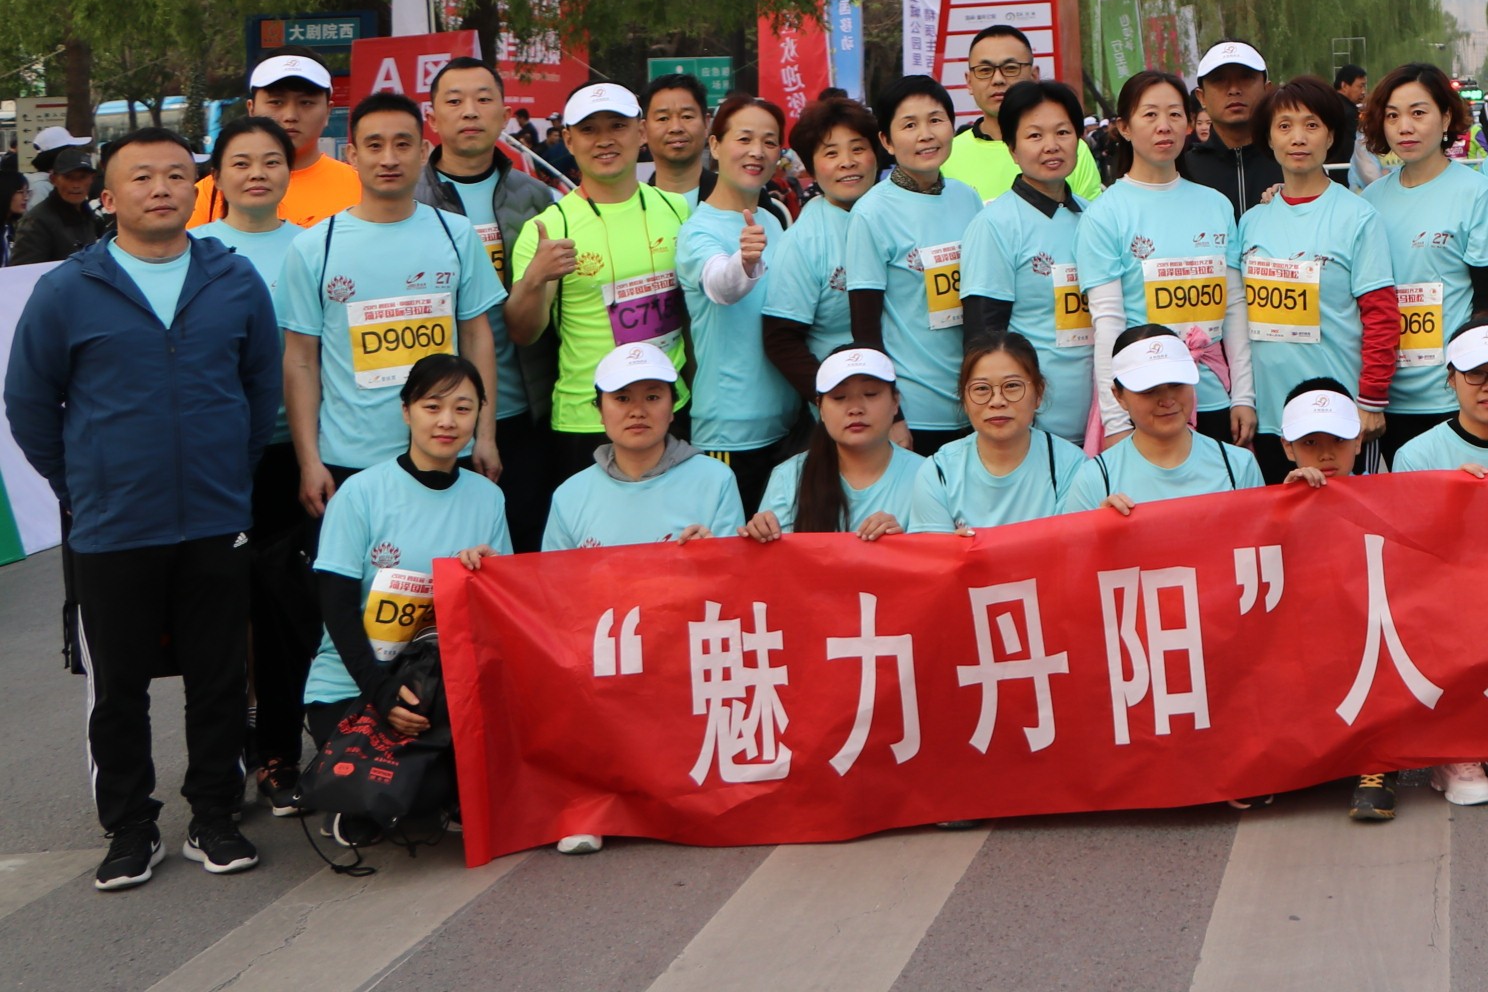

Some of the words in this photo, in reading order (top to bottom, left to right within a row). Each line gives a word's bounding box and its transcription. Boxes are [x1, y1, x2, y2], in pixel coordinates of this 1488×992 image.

[288, 22, 355, 42] 大剧院西
[1155, 283, 1223, 310] D9050
[1245, 284, 1308, 311] D9051
[361, 322, 446, 355] D9060
